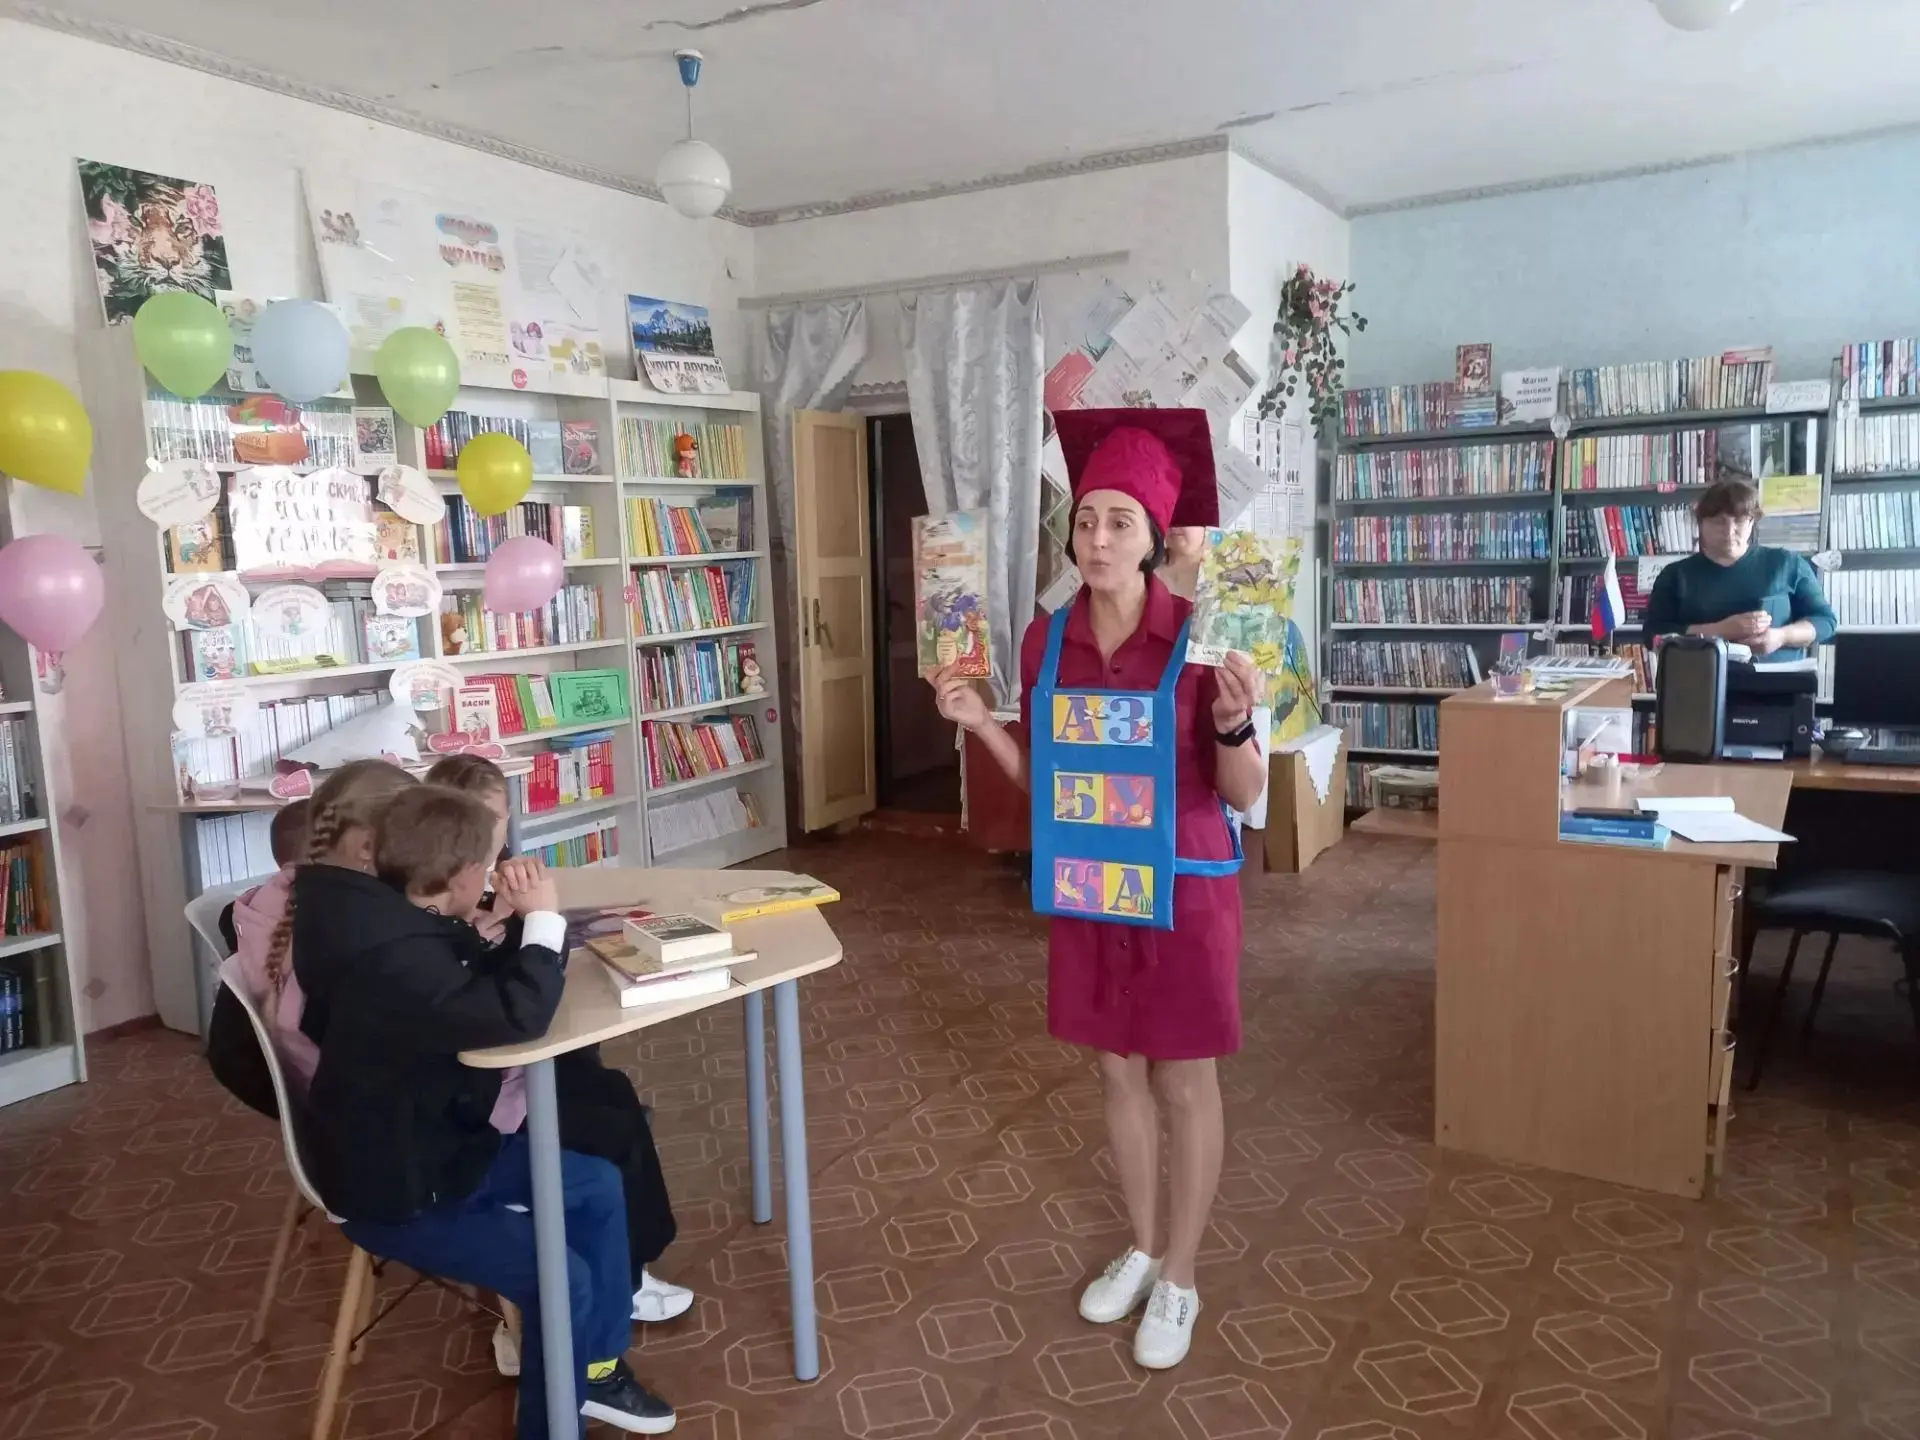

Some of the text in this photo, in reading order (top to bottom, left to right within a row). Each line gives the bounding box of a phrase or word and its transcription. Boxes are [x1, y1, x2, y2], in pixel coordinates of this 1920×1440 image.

[461, 699, 490, 708] БАСНИ
[1054, 696, 1148, 744] АЗ
[1056, 774, 1150, 824] БУ
[1057, 862, 1151, 913] КА
